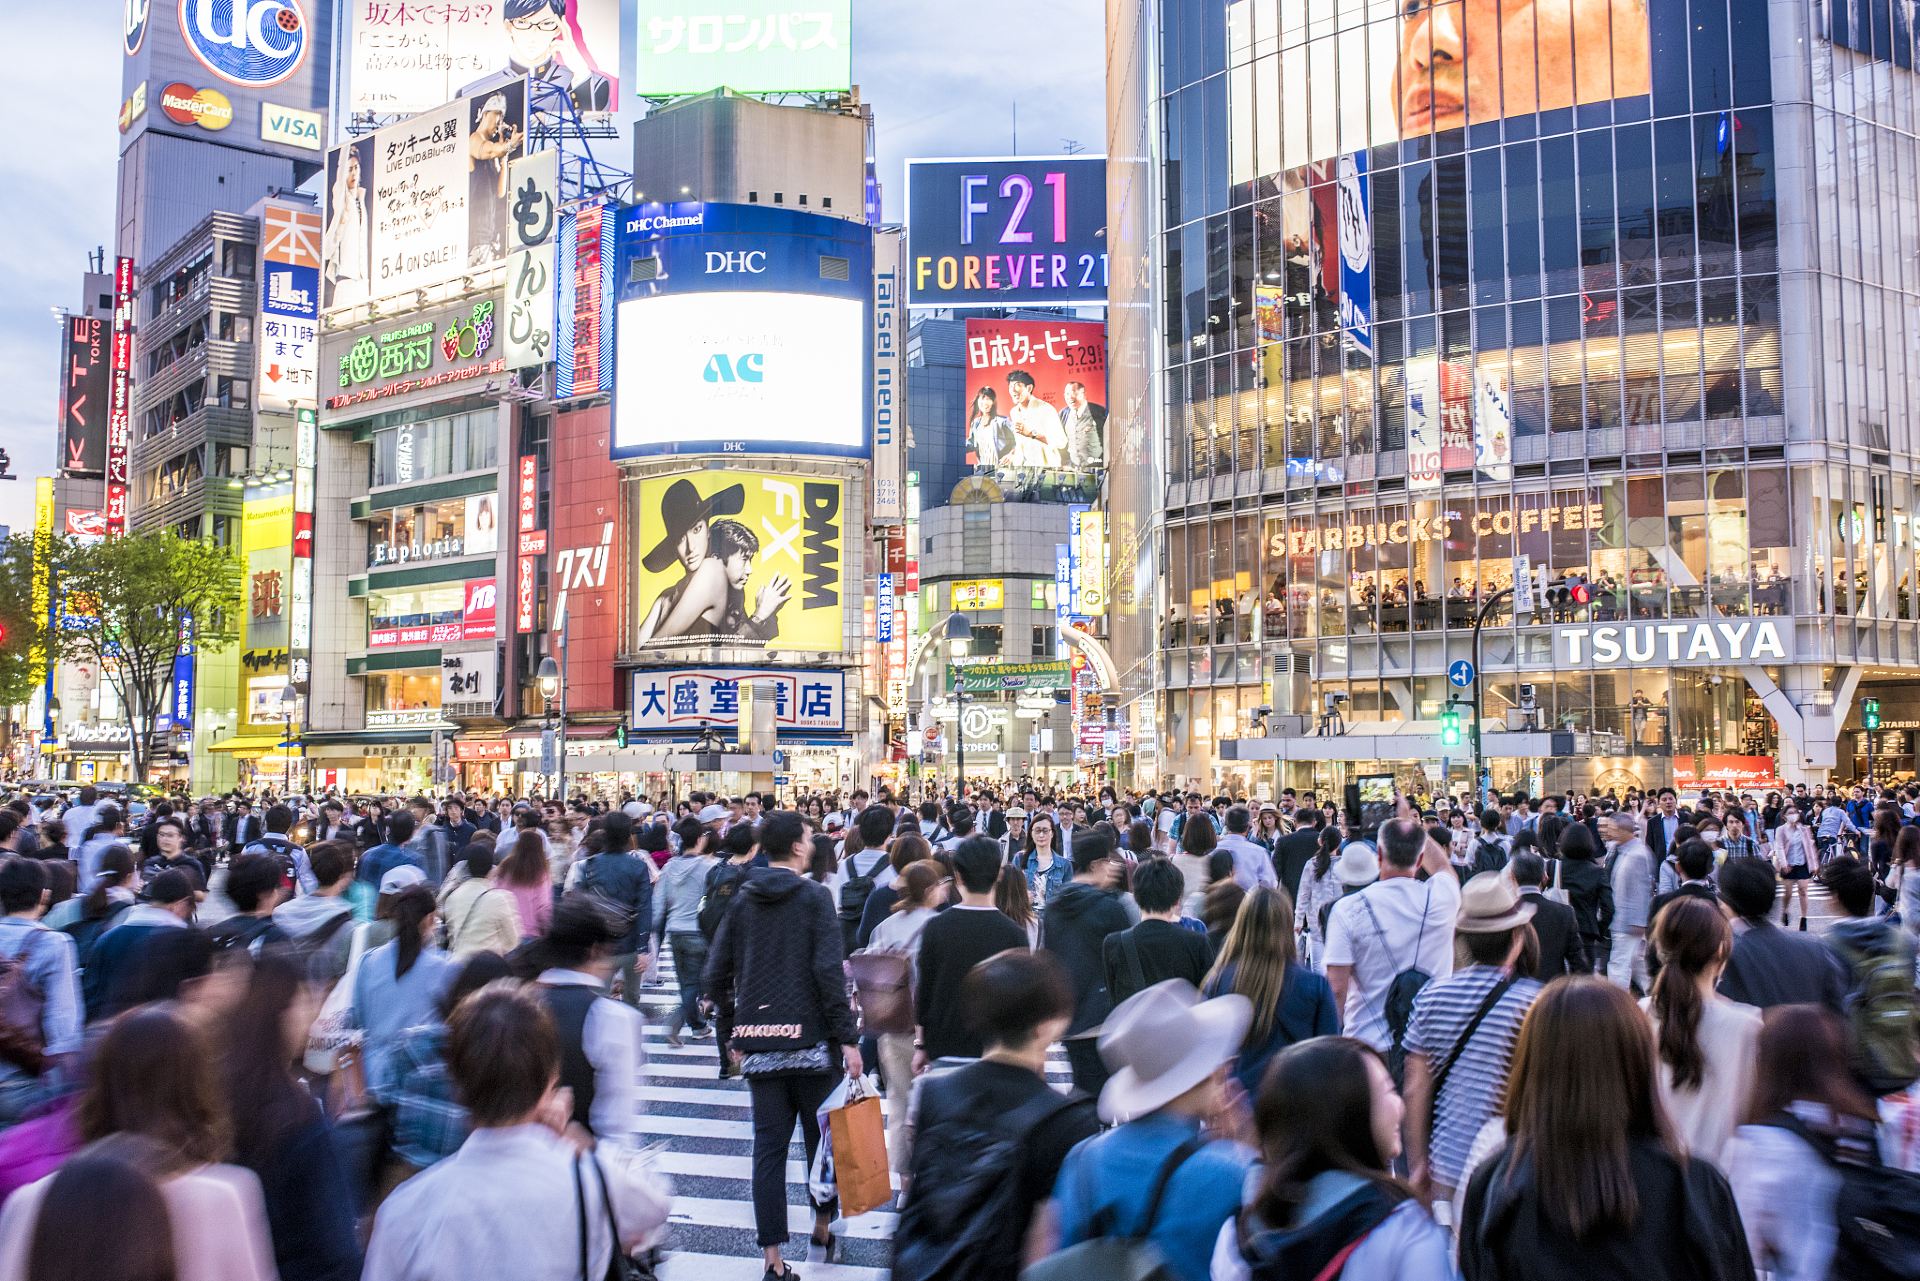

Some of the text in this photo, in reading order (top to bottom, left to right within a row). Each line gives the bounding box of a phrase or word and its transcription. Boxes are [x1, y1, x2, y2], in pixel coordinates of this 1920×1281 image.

[646, 11, 838, 55] サロンパス
[162, 94, 232, 119] MasterCard
[270, 115, 319, 140] VISA
[387, 118, 457, 161] タッキー&翼
[386, 142, 456, 173] LIVE DVD&Blu-ray
[626, 212, 703, 233] DHC Channel
[960, 171, 1068, 246] F21
[264, 210, 321, 265] 本
[381, 252, 403, 279] 5.4
[406, 254, 420, 273] ON
[423, 246, 449, 268] SALE
[511, 176, 553, 358] もんじゃ
[704, 250, 766, 274] DHC
[915, 253, 1068, 291] FOREVER
[877, 264, 896, 358] Taisei
[90, 319, 101, 366] TOKYO
[265, 321, 314, 343] 夜11時
[968, 328, 1080, 369] 日本ダービー
[380, 336, 433, 379] 西村
[703, 353, 763, 383] AC
[1065, 345, 1097, 367] 5.29
[286, 367, 313, 384] 地下
[877, 368, 892, 446] neon
[723, 442, 746, 452] DHC
[876, 488, 897, 498] 3719
[877, 479, 895, 489] (03)
[761, 477, 801, 565] FX
[1270, 502, 1605, 558] STARBUCKS COFFEE
[375, 534, 461, 564] Euphoria
[803, 481, 840, 611] DMM
[252, 569, 283, 618] 薬
[552, 521, 614, 631] クスリ
[466, 584, 496, 615] JTB
[1560, 621, 1787, 664] TSUTAYA
[68, 722, 131, 742] グルメタウン
[955, 743, 998, 752] IS'DEMO
